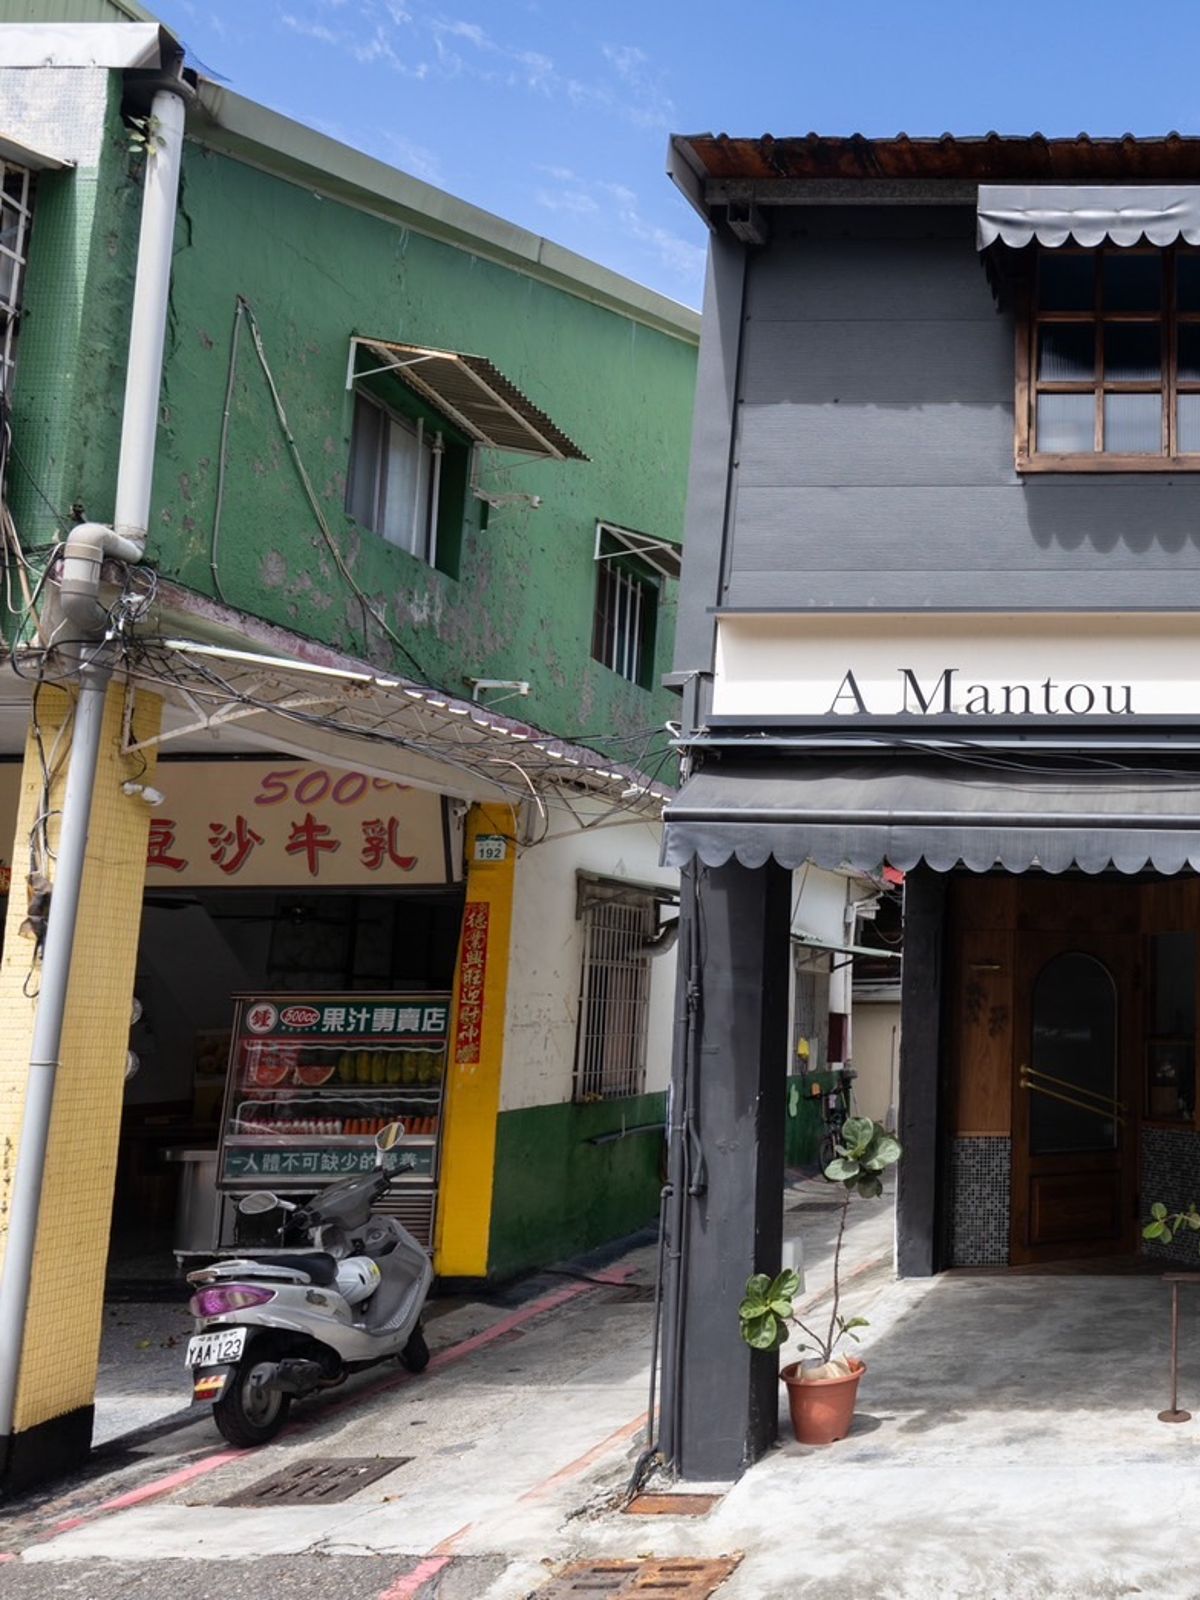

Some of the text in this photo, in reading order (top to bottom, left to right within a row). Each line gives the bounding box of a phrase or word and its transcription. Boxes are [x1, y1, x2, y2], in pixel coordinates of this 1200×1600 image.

[824, 668, 1136, 715] A Mantou
[479, 847, 502, 859] 192
[284, 1009, 318, 1024] 500cc
